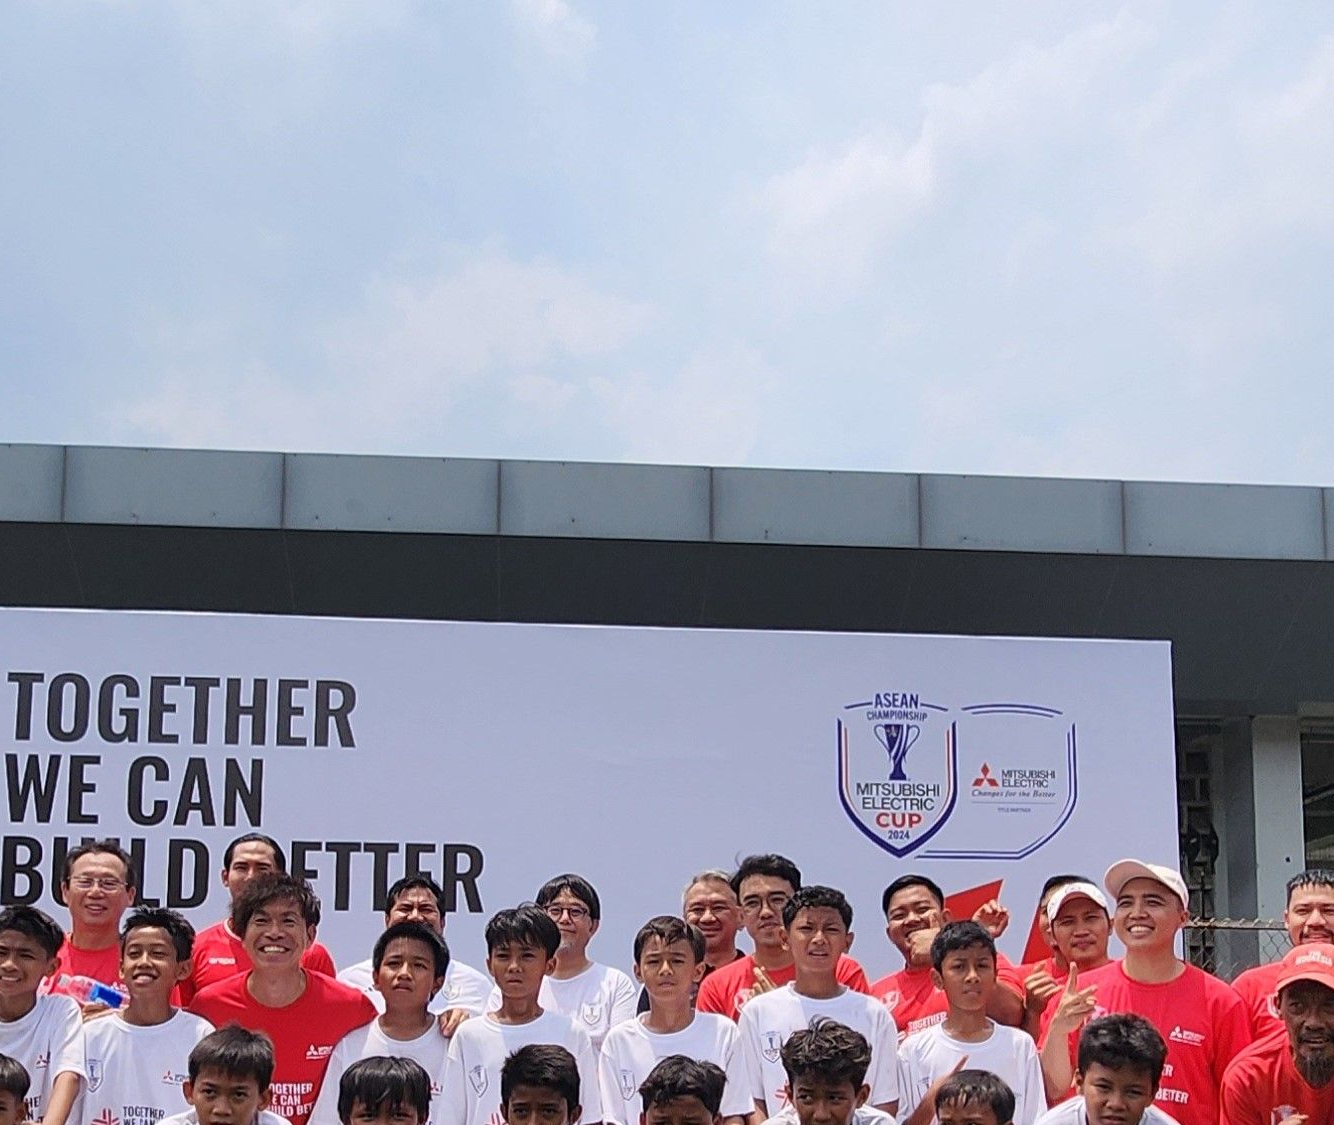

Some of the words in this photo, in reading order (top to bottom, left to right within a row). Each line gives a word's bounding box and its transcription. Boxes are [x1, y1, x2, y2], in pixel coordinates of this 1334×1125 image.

[874, 692, 919, 709] ASEAN
[7, 672, 357, 748] TOGETHER
[866, 710, 928, 722] CHAMPIONSHIP
[1001, 769, 1056, 779] MITSUBISHI
[856, 782, 940, 797] MITSUBISHI
[1001, 778, 1049, 788] ELECTRIC
[4, 753, 102, 825] WE
[126, 755, 265, 828] CAN
[971, 789, 1003, 798] Changes
[1005, 789, 1017, 798] for
[1018, 789, 1031, 798] the
[1033, 789, 1056, 798] Better
[862, 797, 935, 811] ELECTRIC
[875, 812, 922, 829] CUP
[888, 829, 910, 840] 2024
[290, 841, 484, 914] ETTER
[268, 1082, 313, 1096] OGETHER
[280, 1094, 301, 1106] CAN
[123, 1105, 165, 1120] TOGETHER
